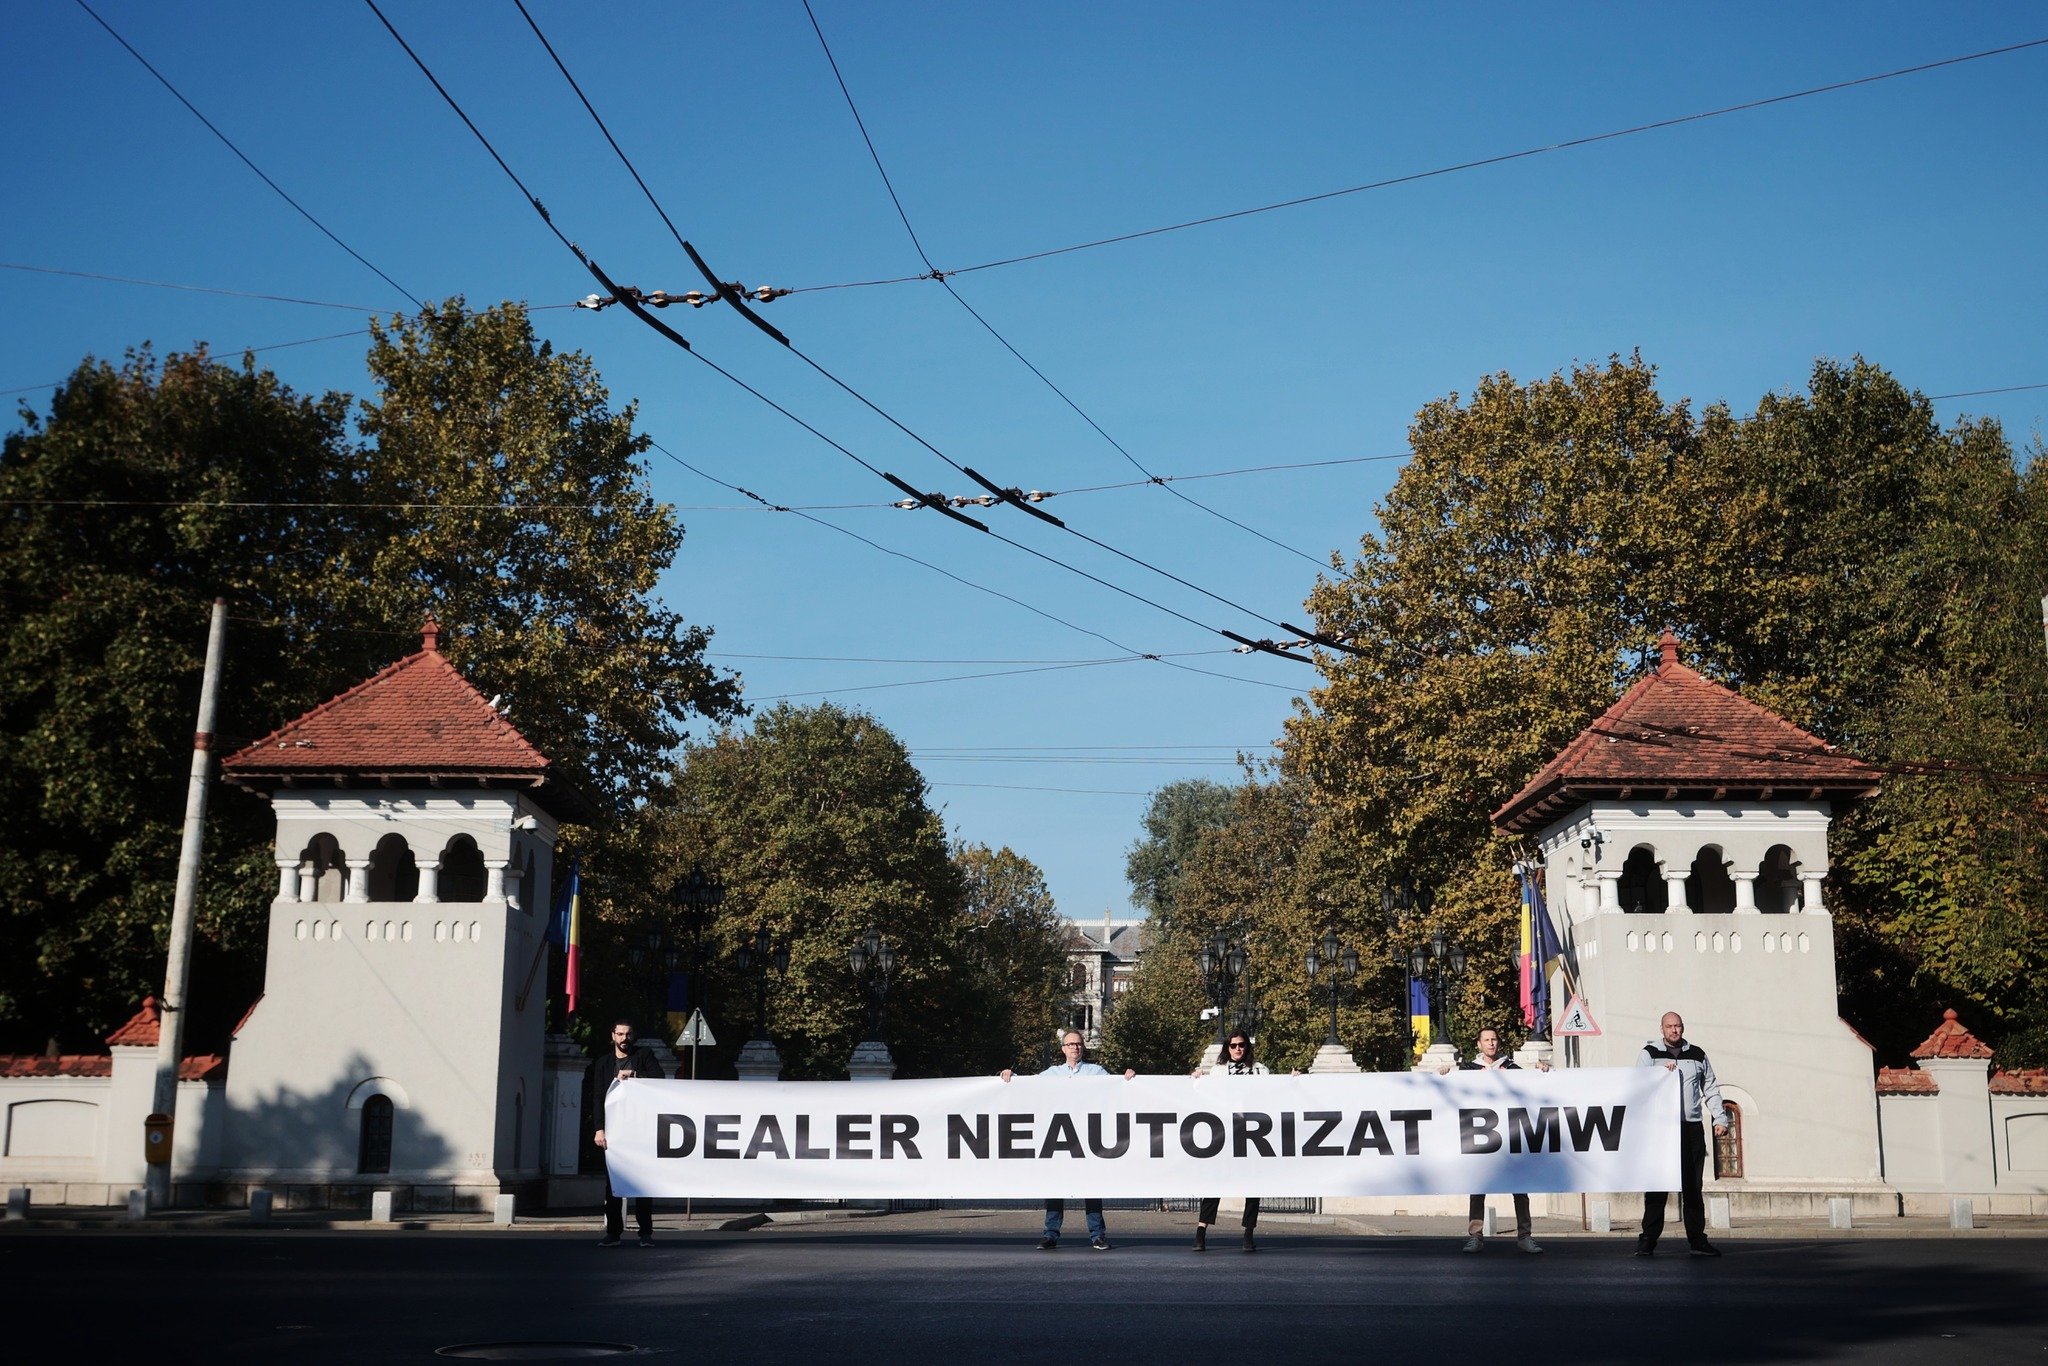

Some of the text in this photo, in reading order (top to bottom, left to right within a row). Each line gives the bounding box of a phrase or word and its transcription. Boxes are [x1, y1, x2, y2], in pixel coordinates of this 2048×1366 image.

[657, 1105, 1627, 1160] DEALER NEAUTORIZAT BMW
